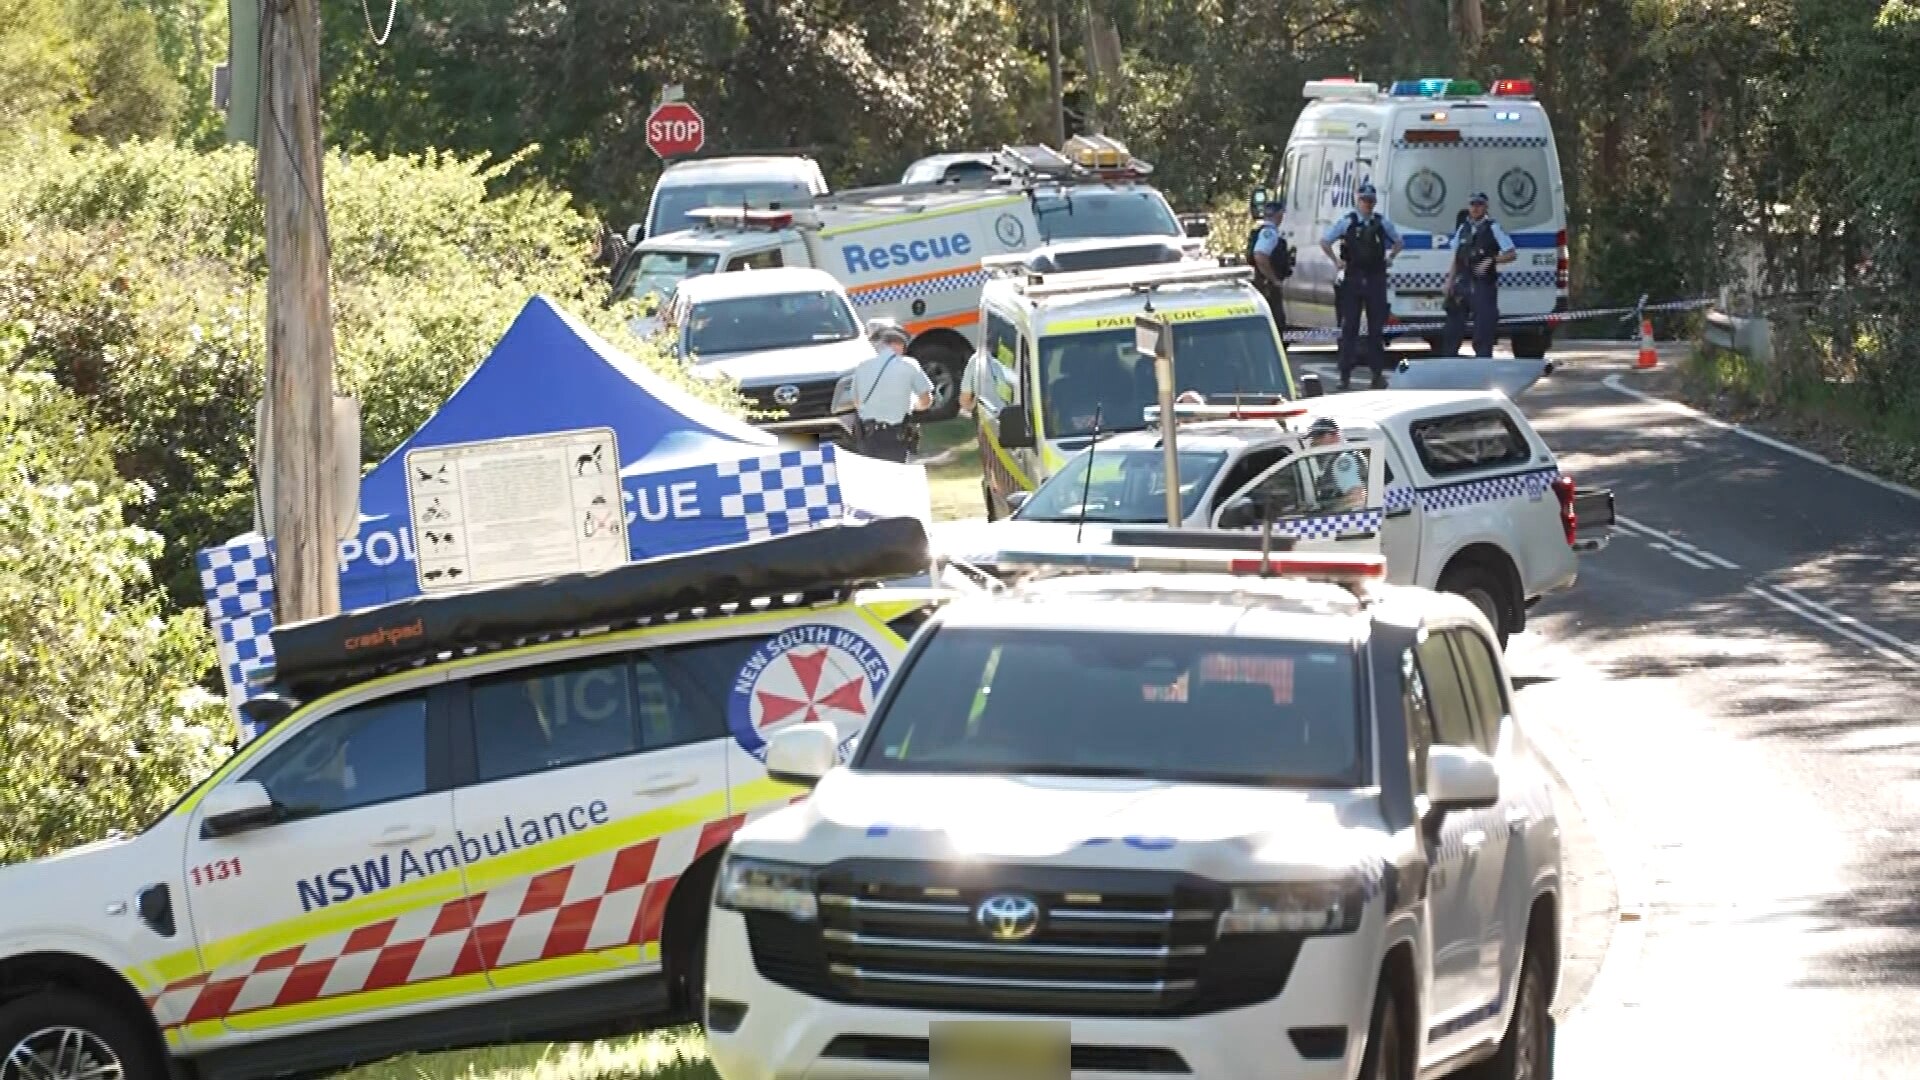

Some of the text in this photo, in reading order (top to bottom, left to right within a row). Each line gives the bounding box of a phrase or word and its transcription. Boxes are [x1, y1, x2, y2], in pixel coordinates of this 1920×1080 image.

[651, 120, 700, 141] STOP
[842, 232, 972, 273] Rescue
[1096, 310, 1206, 328] PARMEDIC
[734, 626, 888, 694] NEW SOUTH WALES
[190, 857, 242, 887] 1131
[296, 800, 609, 912] NSW Ambulance
